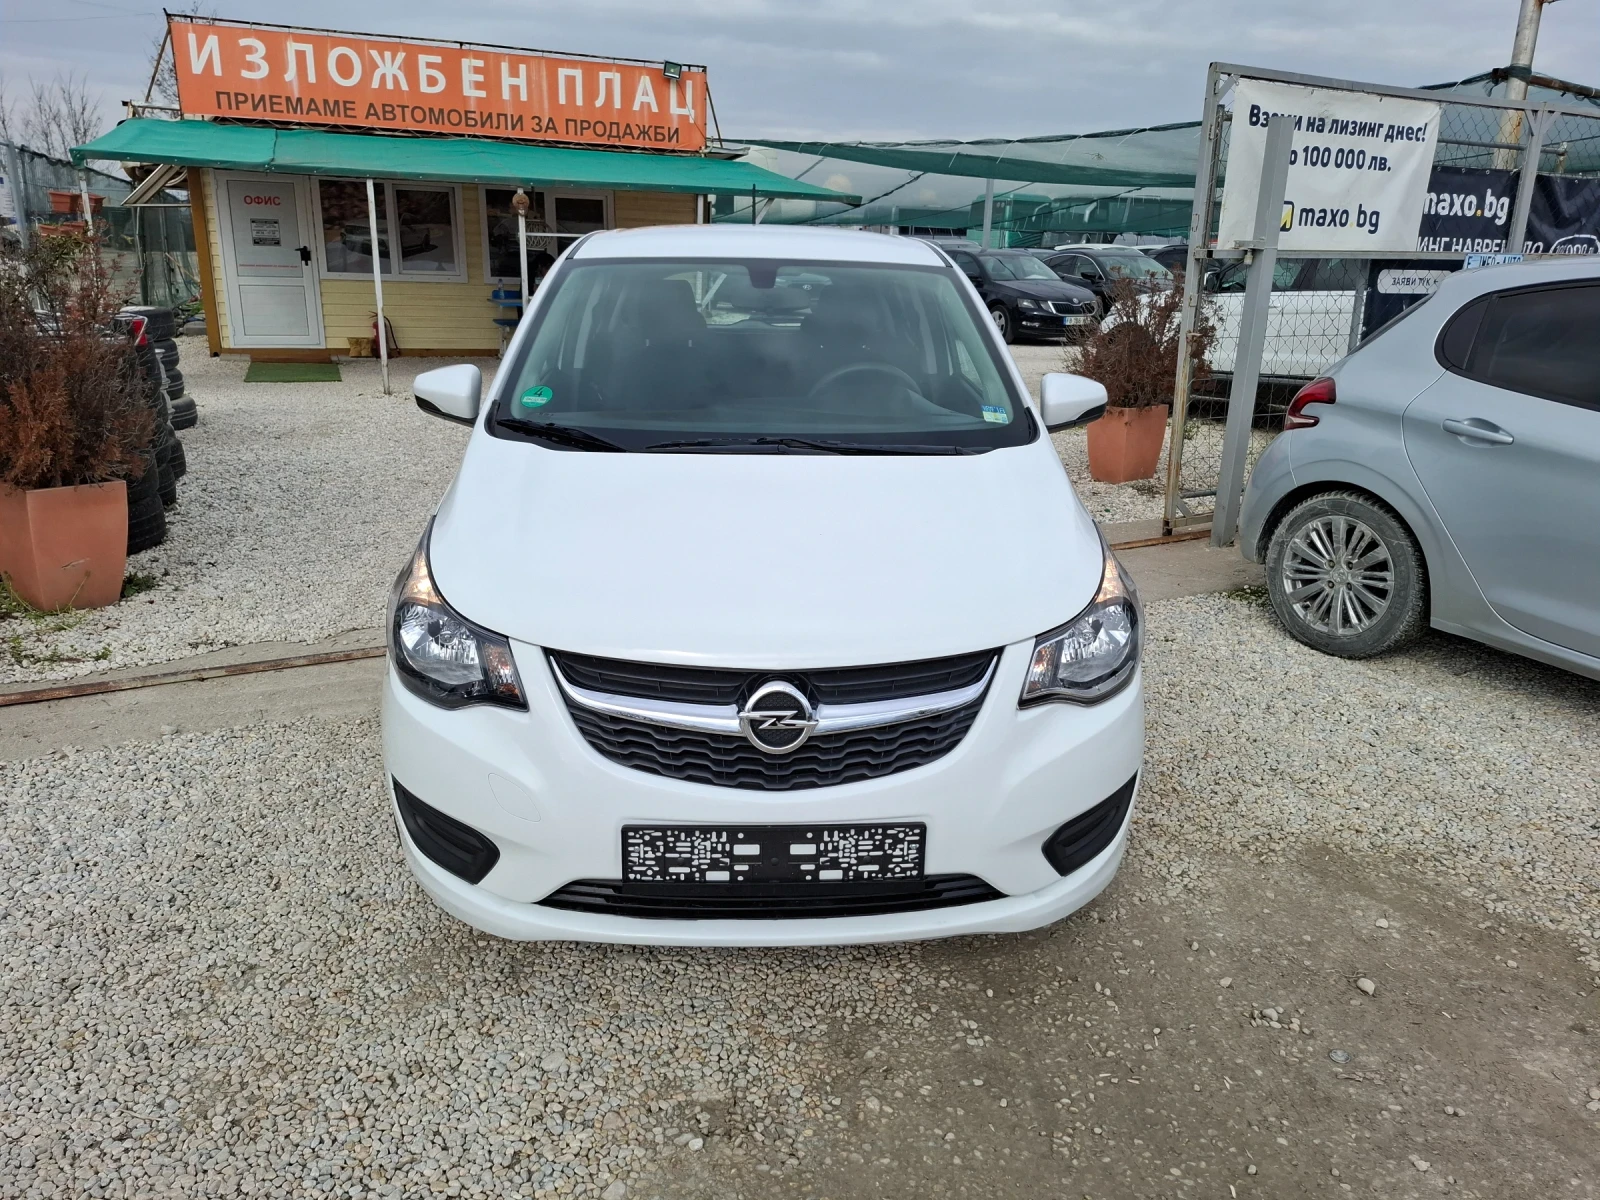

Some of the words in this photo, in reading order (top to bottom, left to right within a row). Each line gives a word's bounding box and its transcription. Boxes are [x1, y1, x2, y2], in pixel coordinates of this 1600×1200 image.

[188, 32, 528, 102] ИЗЛОЖБЕН
[558, 67, 696, 124] ПЛАЦ
[215, 90, 358, 119] ПРИЕМАМЕ
[364, 102, 525, 132] АВТОМОБИЛИ
[531, 115, 559, 135] ЗА
[565, 118, 680, 144] ПРОДАЖБИ
[1249, 104, 1303, 131] Взи
[1305, 116, 1326, 134] на
[1328, 118, 1384, 138] лизинг
[1384, 123, 1428, 143] днес!
[1302, 145, 1331, 168] 100
[1334, 147, 1366, 170] 000
[1367, 155, 1392, 172] лв.
[243, 195, 281, 206] ОФИС
[1298, 203, 1380, 235] maxo.bg
[1391, 277, 1417, 286] ЗАЯВИ
[533, 387, 545, 397] 4
